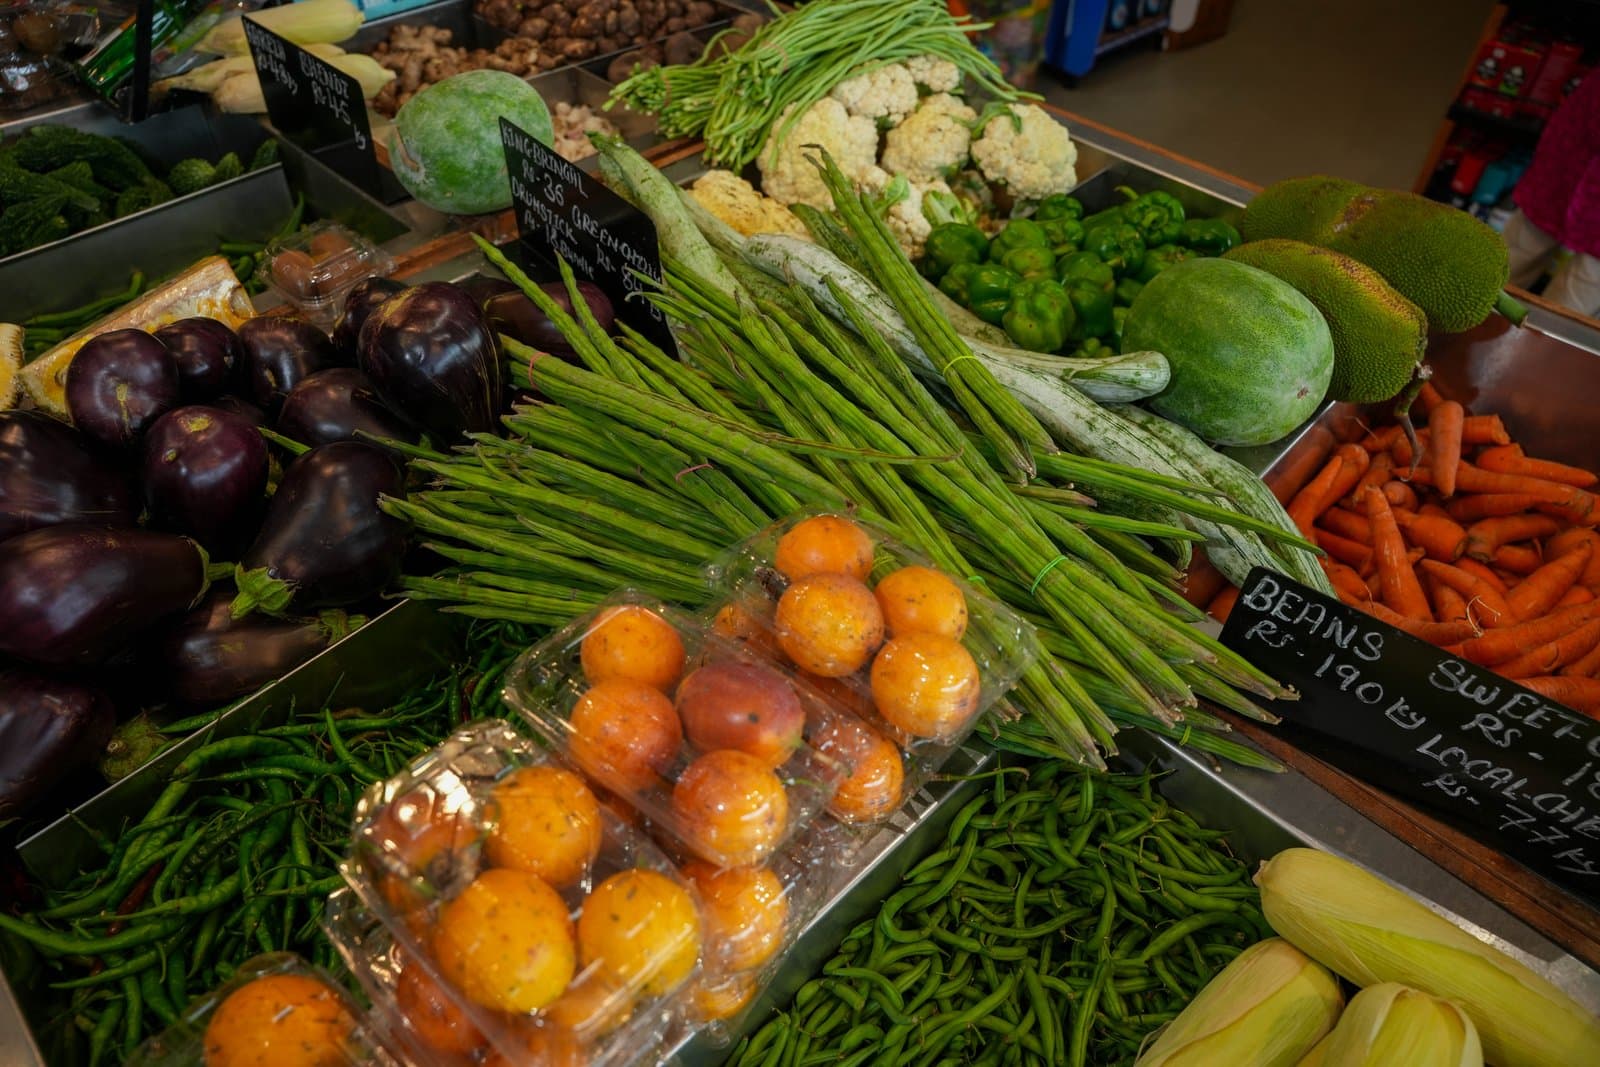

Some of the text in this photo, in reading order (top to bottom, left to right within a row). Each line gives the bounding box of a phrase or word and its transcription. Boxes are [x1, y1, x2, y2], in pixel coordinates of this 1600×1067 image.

[512, 175, 578, 245] DRUMSTICK
[1243, 576, 1384, 661] BEANS
[1429, 659, 1589, 738] SWEET
[1499, 803, 1569, 844] 77
